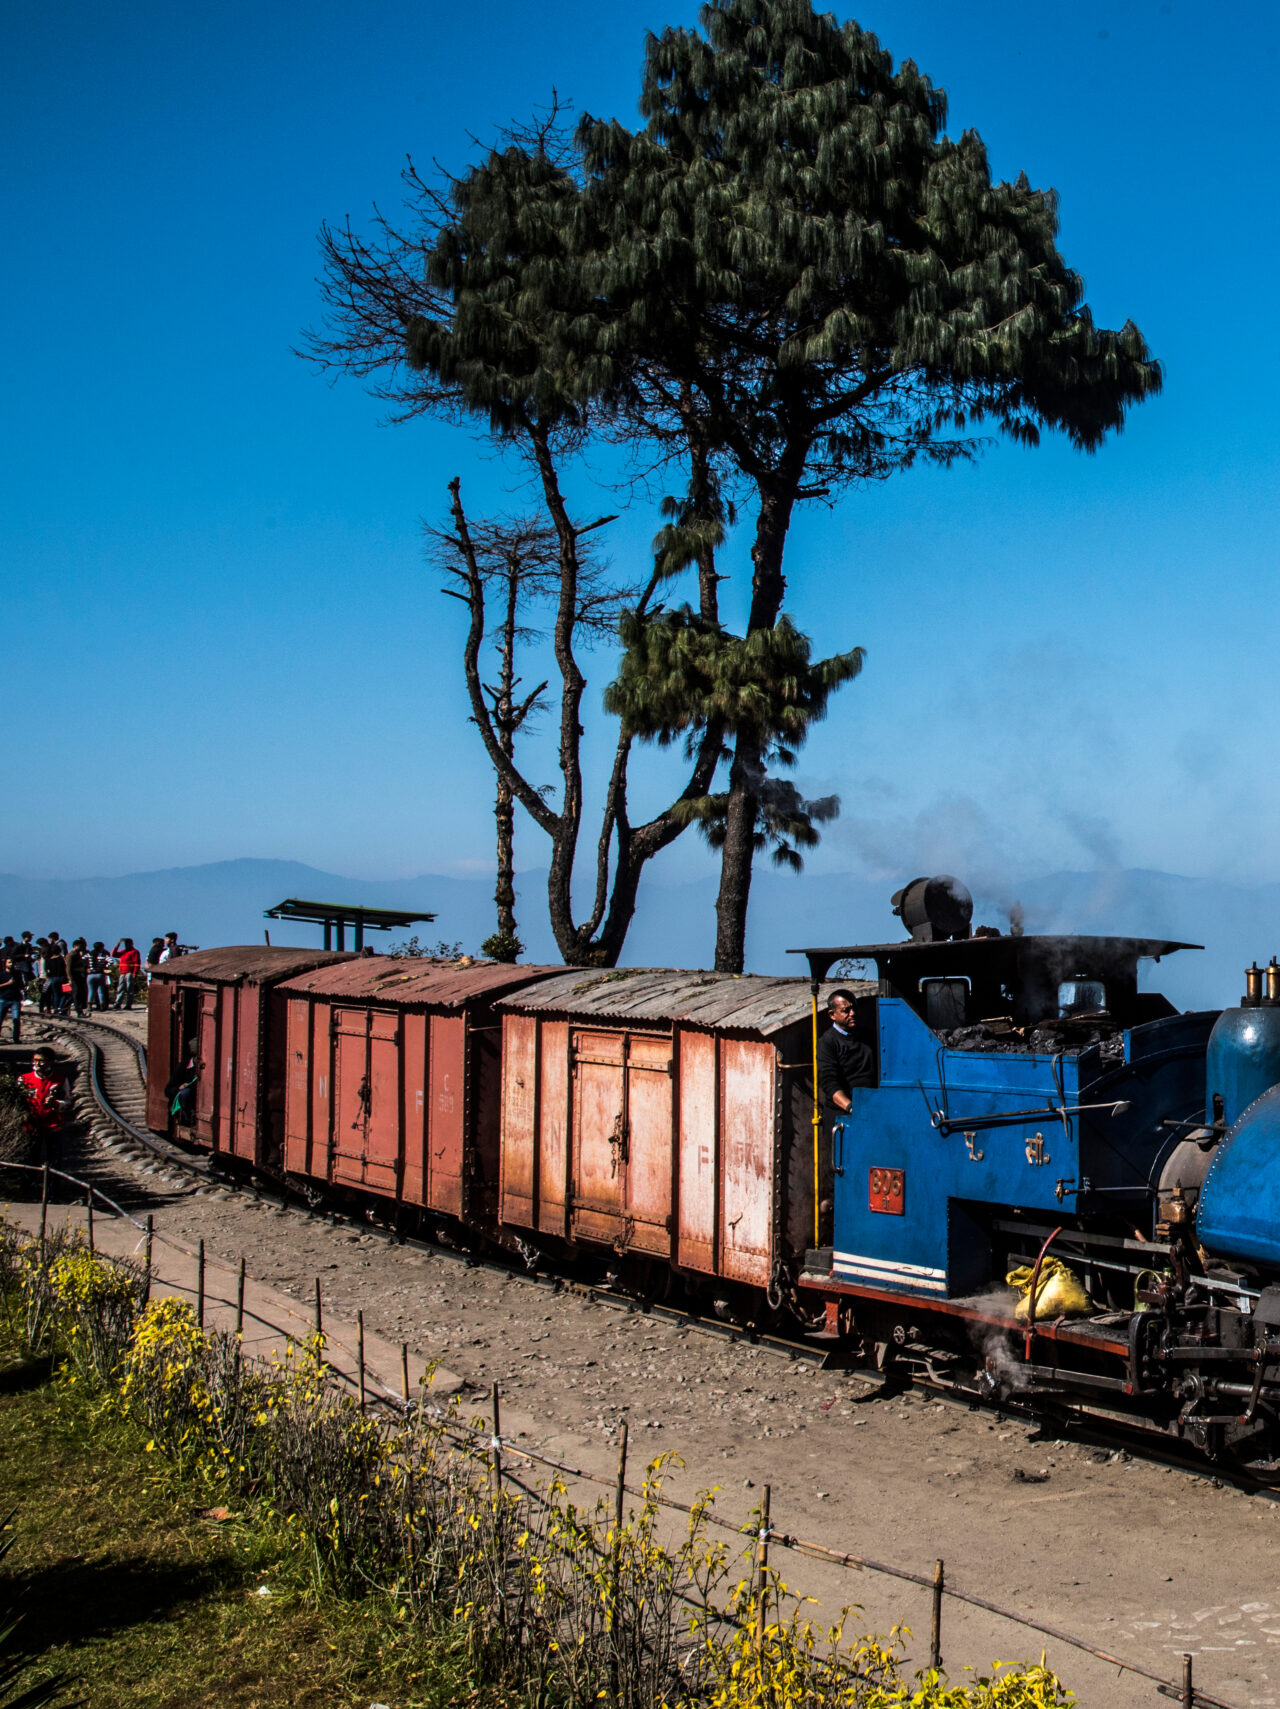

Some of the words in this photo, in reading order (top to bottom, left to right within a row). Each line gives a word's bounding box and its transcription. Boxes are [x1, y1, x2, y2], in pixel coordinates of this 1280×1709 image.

[319, 1075, 327, 1098] N
[443, 1073, 449, 1092] C
[416, 1090, 424, 1114] F
[698, 1145, 709, 1175] F
[871, 1169, 901, 1197] 806
